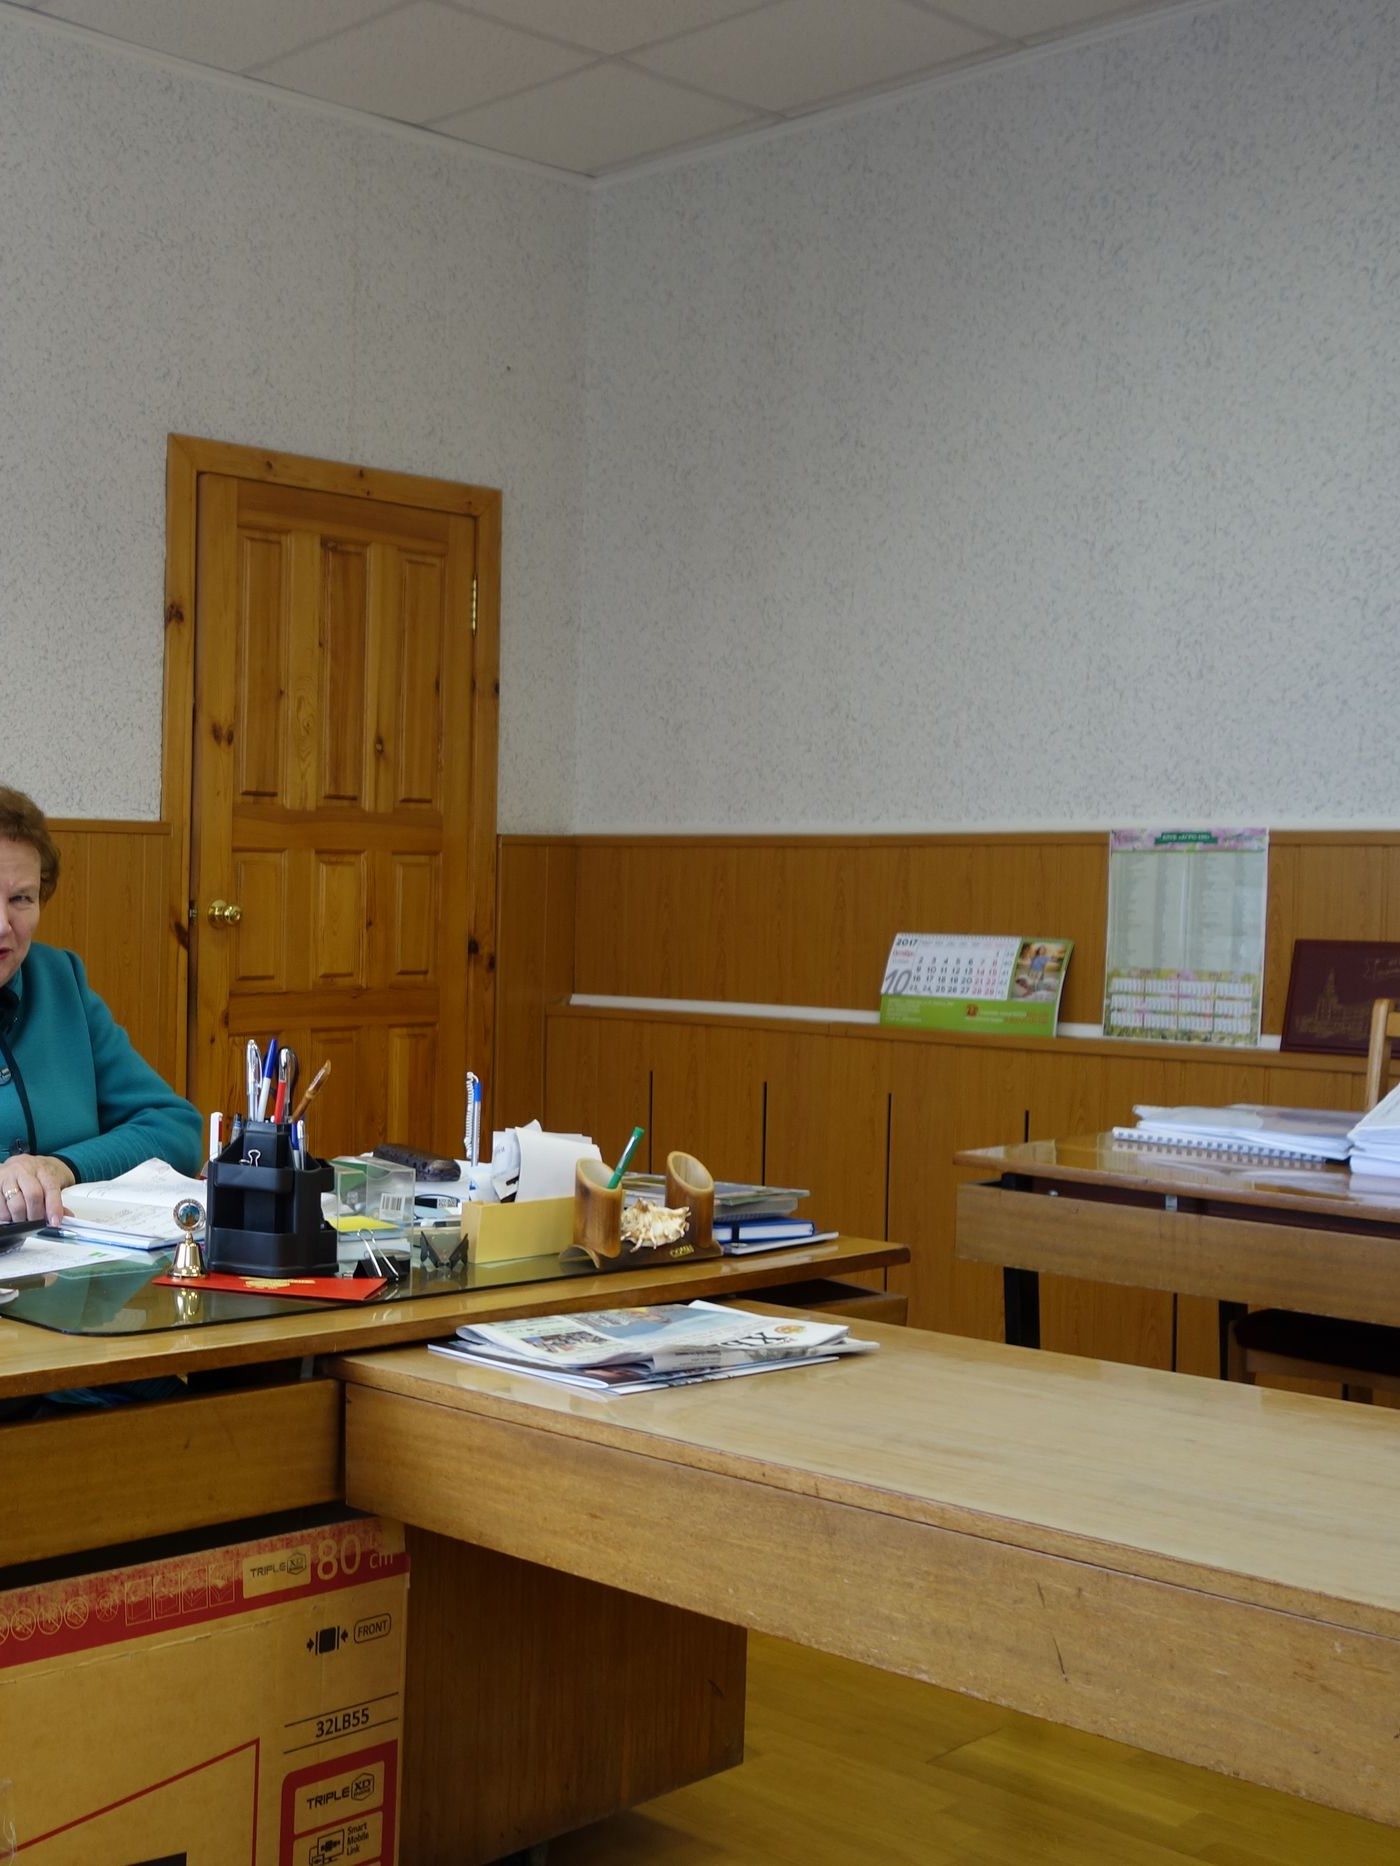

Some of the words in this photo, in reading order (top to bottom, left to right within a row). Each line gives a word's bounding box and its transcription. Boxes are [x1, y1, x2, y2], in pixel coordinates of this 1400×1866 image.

[895, 937, 918, 946] 2017
[884, 968, 912, 996] 10
[317, 1534, 361, 1580] 80
[369, 1551, 393, 1569] cm
[250, 1561, 287, 1578] TRIPLE
[357, 1620, 388, 1638] FRONT
[315, 1707, 369, 1738] 32LB55
[307, 1786, 350, 1809] TRIPLE
[347, 1823, 368, 1835] Smart
[347, 1831, 369, 1846] Mobile
[346, 1845, 360, 1856] Link
